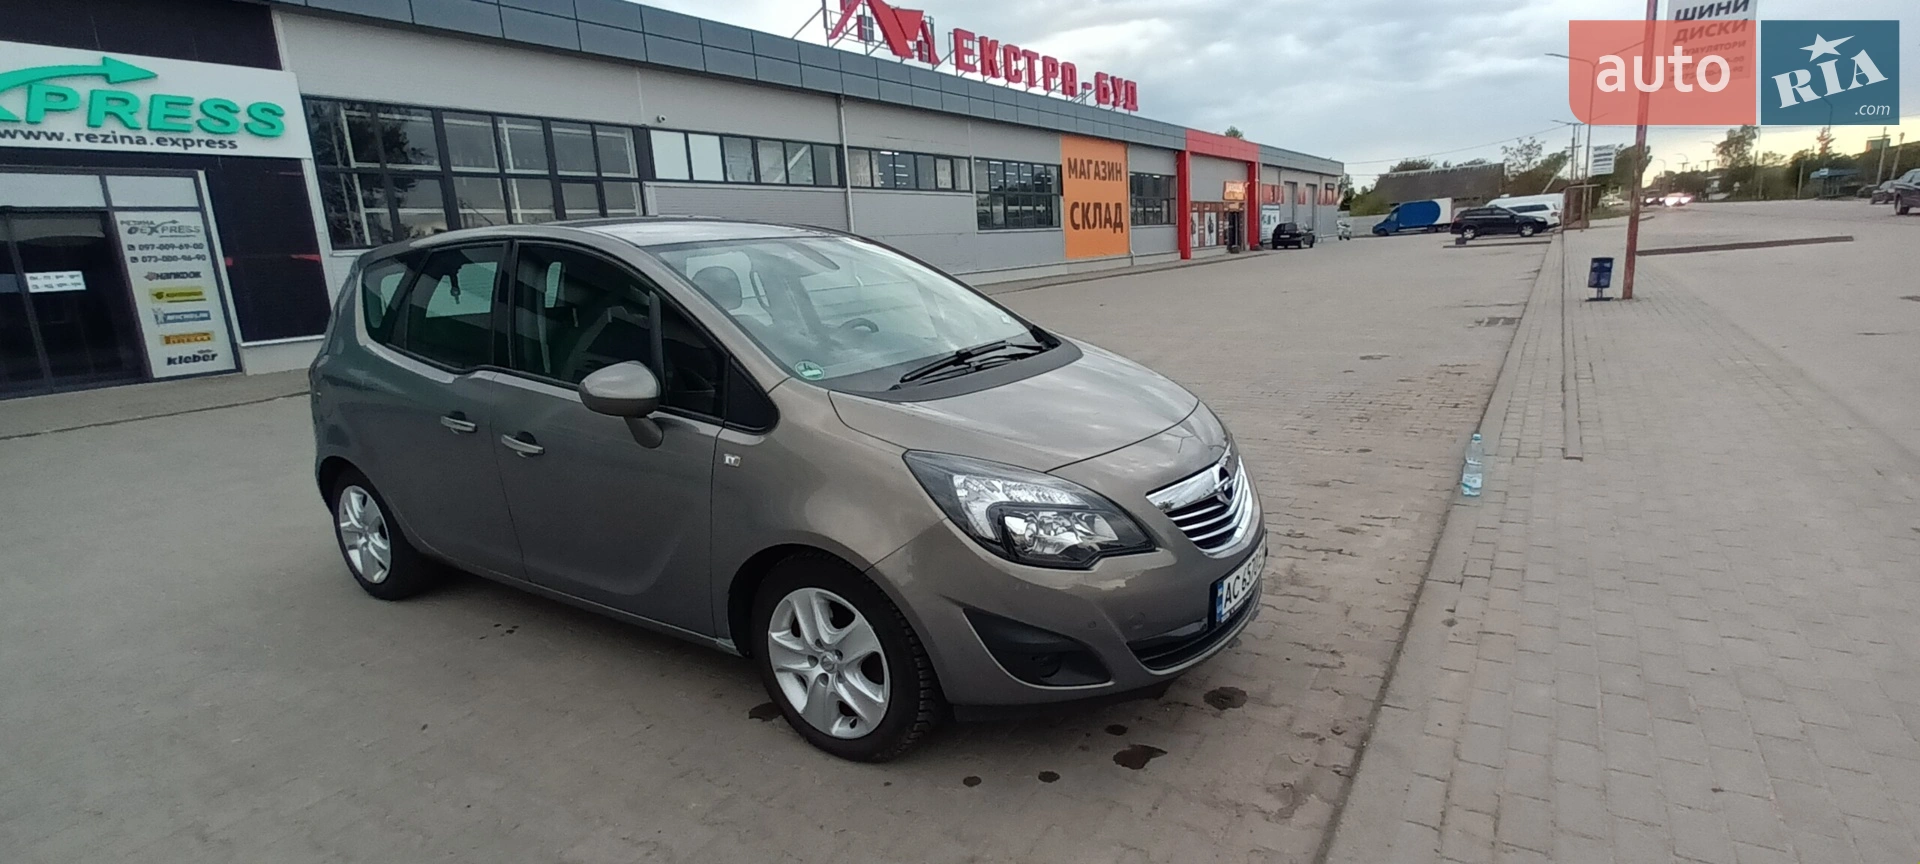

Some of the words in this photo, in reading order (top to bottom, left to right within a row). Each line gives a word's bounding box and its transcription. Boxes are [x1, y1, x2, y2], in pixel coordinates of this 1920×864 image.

[1675, 0, 1750, 23] ШИНИ
[1673, 19, 1748, 45] ДИСКИ
[0, 129, 238, 150] www.rezina.express
[1067, 157, 1123, 182] МАГАЗИН
[1069, 201, 1124, 234] СКЛАД
